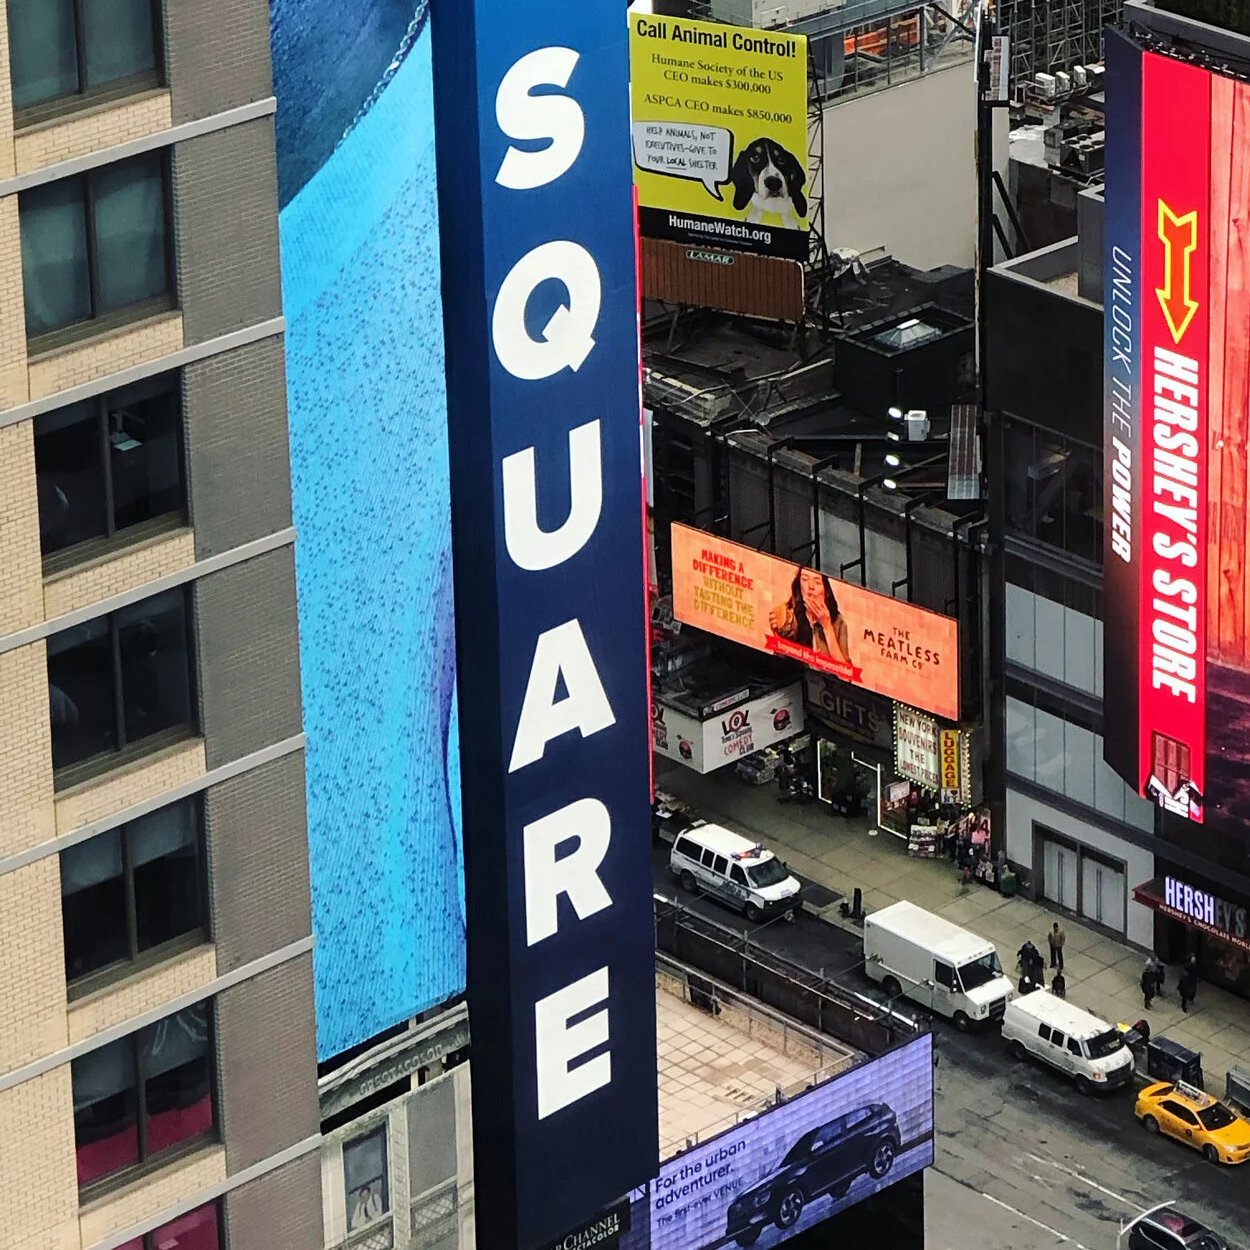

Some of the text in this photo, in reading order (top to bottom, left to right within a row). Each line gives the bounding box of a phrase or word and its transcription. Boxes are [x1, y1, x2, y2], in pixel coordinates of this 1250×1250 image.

[637, 19, 797, 58] Call Animal Control!
[651, 53, 784, 82] Humane Society of the US
[663, 70, 771, 95] CEO makes $300,000
[644, 93, 793, 124] ASPCA CEO makes $850,000
[646, 126, 663, 136] HELP
[666, 156, 687, 167] LOCAL
[688, 157, 719, 171] SHELTER
[668, 214, 772, 245] HumaneWatch.org
[688, 250, 731, 265] LAMAR
[1111, 245, 1132, 564] UNLOCK THE POWER
[1152, 345, 1199, 704] HERSHEY'S STORE
[692, 558, 755, 591] DIFFERENCE
[701, 549, 745, 575] MAKING A
[491, 45, 616, 1121] SQUARE
[694, 586, 734, 609] TASTING
[703, 576, 744, 600] WITHOUT
[694, 600, 755, 631] DIFFERENCE
[863, 628, 941, 666] MEATLESS
[893, 627, 910, 640] THE
[880, 648, 908, 665] FARM
[820, 691, 881, 732] GIFTS
[899, 711, 938, 738] NEW YORK
[723, 734, 754, 757] COMEDY
[898, 726, 938, 756] SOUVENIRS
[909, 749, 925, 764] THE
[943, 732, 957, 788] LUGGAGE
[1164, 875, 1248, 938] HERSHEY'S
[654, 1139, 747, 1194] For the urban
[655, 1162, 735, 1210] adventurer.
[656, 1213, 673, 1228] The
[713, 1177, 745, 1199] VENUE
[563, 1213, 621, 1250] CHANNEL
